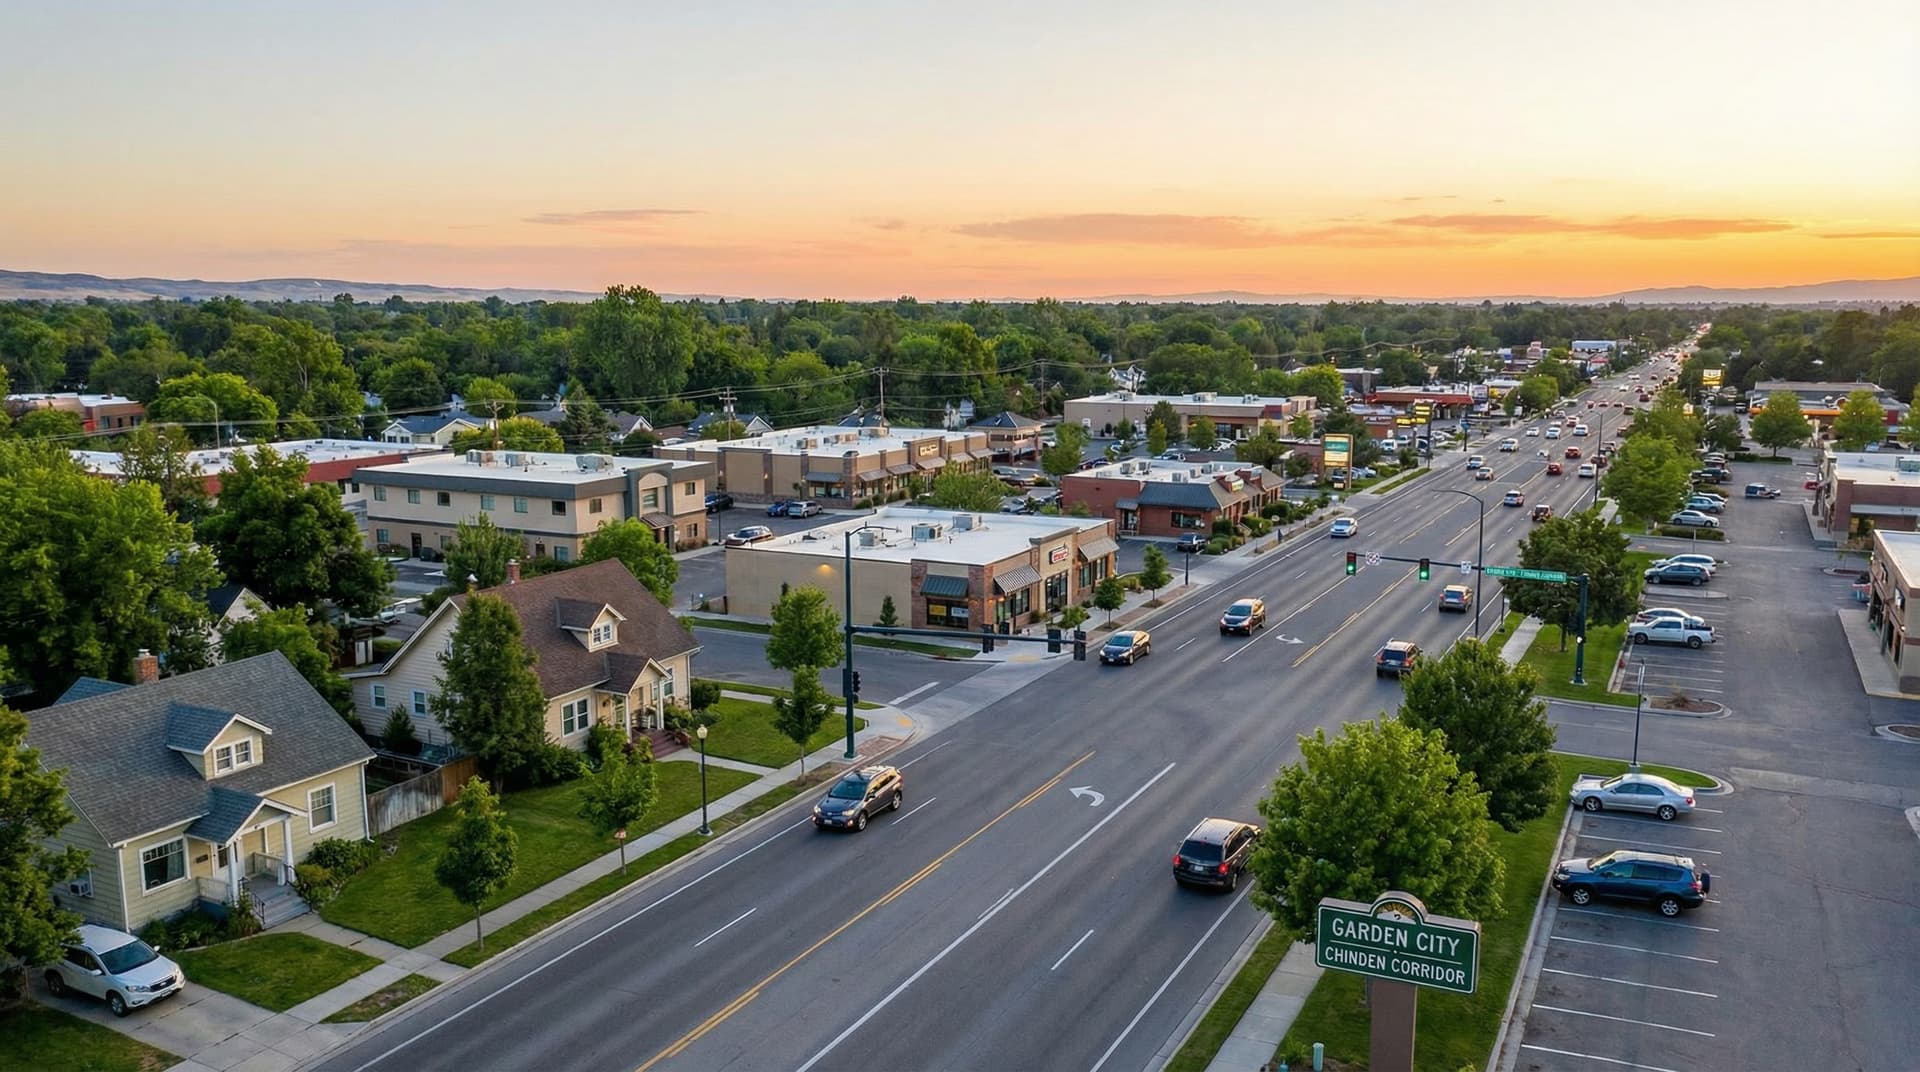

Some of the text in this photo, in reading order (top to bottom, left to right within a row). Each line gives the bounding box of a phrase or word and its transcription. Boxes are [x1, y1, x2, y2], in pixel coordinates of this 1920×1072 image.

[1332, 918, 1460, 956] GARDEN CITY
[1325, 947, 1465, 985] CHINDEN CORRIDOR
